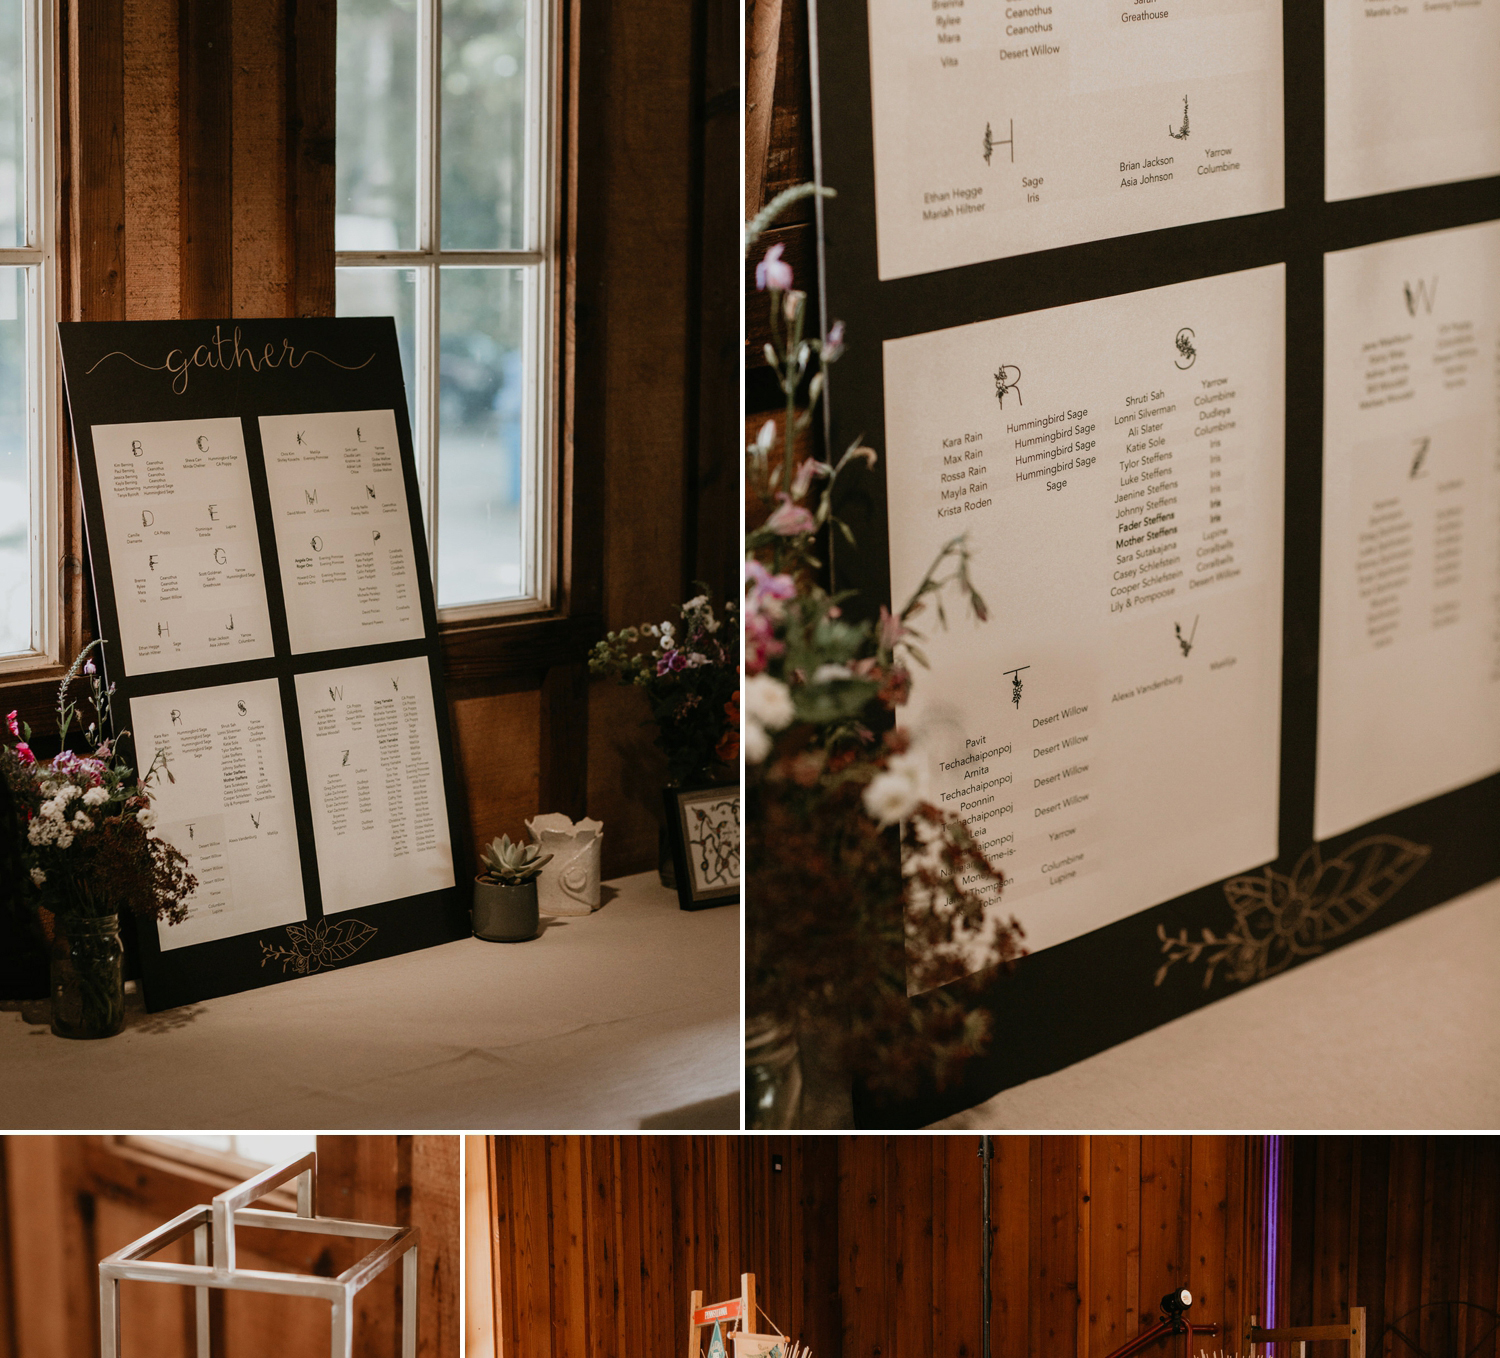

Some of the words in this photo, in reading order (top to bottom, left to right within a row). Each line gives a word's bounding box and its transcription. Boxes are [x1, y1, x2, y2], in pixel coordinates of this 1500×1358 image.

[1006, 5, 1052, 19] Ceanothus
[1121, 10, 1169, 23] Greathouse
[1006, 22, 1053, 36] Ceanothus
[1000, 47, 1028, 60] Desert
[1029, 44, 1060, 57] Willow
[983, 119, 1013, 166] H
[1204, 146, 1232, 158] Yarrow
[1119, 159, 1140, 172] Brian
[1142, 155, 1174, 170] Jackson
[1197, 160, 1240, 176] Columbine
[1022, 176, 1044, 188] Sage
[1120, 176, 1138, 188] Asia
[1140, 171, 1173, 186] Johnson
[924, 189, 950, 204] Ethan
[952, 186, 983, 201] Hegge
[1027, 192, 1040, 203] Iris
[922, 205, 953, 221] Mariah
[956, 202, 985, 216] Hiltner
[994, 364, 1023, 410] R
[1201, 376, 1228, 389] Yarrow
[1125, 393, 1149, 407] Shruti
[1149, 389, 1165, 402] Sah
[1194, 389, 1236, 406] Columbine
[1006, 412, 1065, 434] Hummingbird
[1067, 408, 1088, 422] Sage
[1114, 411, 1136, 425] Lonni
[1138, 403, 1176, 420] Silverman
[1199, 406, 1231, 421] Dudleya
[1014, 427, 1073, 449] Hummingbird
[1075, 423, 1096, 436] Sage
[1128, 426, 1139, 438] Ali
[1141, 422, 1163, 435] Slater
[1194, 420, 1236, 438] Columbine
[132, 440, 143, 457] B
[196, 436, 209, 453] C
[942, 435, 960, 449] Kara
[961, 432, 983, 445] Rain
[1126, 440, 1146, 454] Katie
[1148, 436, 1166, 449] Sole
[943, 453, 961, 466] Max
[962, 449, 983, 462] Rain
[1015, 443, 1073, 466] Hummingbird
[1075, 439, 1096, 453] Sage
[1119, 457, 1138, 472] Tylor
[1140, 450, 1173, 467] Steffens
[940, 469, 964, 484] Rossa
[966, 465, 987, 479] Rain
[1016, 459, 1074, 483] Hummingbird
[1075, 456, 1097, 470] Sage
[1120, 473, 1138, 487] Luke
[1141, 466, 1172, 482] Steffens
[941, 486, 966, 501] Mayla
[969, 481, 988, 495] Rain
[1046, 479, 1067, 492] Sage
[1114, 487, 1144, 504] Jaenine
[1146, 480, 1178, 496] Steffens
[208, 504, 219, 521] E
[937, 503, 962, 519] Krista
[964, 498, 992, 512] Roden
[1115, 502, 1144, 519] Johnny
[1145, 495, 1178, 512] Steffens
[142, 510, 154, 527] D
[1118, 518, 1141, 533] Fader
[1143, 511, 1175, 528] Steffens
[1116, 534, 1144, 550] Mother
[1146, 526, 1178, 542] Steffens
[1116, 552, 1133, 565] Sara
[1136, 540, 1177, 559] Sutakajana
[1113, 565, 1139, 582] Casey
[1140, 555, 1181, 574] Schlefstein
[1110, 580, 1140, 599] Cooper
[1142, 569, 1183, 588] Schlefstein
[1110, 598, 1124, 614] Lily
[1126, 597, 1132, 607] &
[1133, 585, 1175, 605] Pompoose
[1111, 688, 1135, 703] Alexis
[1136, 674, 1183, 697] Vandenburg
[1032, 713, 1059, 729] Desert
[1061, 704, 1088, 720] Willow
[965, 735, 986, 749] Pavit
[1033, 743, 1060, 759] Desert
[1062, 733, 1089, 750] Willow
[939, 743, 1012, 773] Techachaiponpoj
[1033, 773, 1060, 788] Desert
[1063, 763, 1089, 779] Willow
[940, 773, 1013, 803] Techachaiponpoj
[960, 793, 995, 812] Poonnin
[1034, 803, 1061, 818] Desert
[1063, 792, 1089, 809] Willow
[969, 826, 987, 839] Leia
[1048, 827, 1076, 843] Yarrow
[1041, 852, 1084, 874] Columbine
[1050, 869, 1076, 886] Lupine
